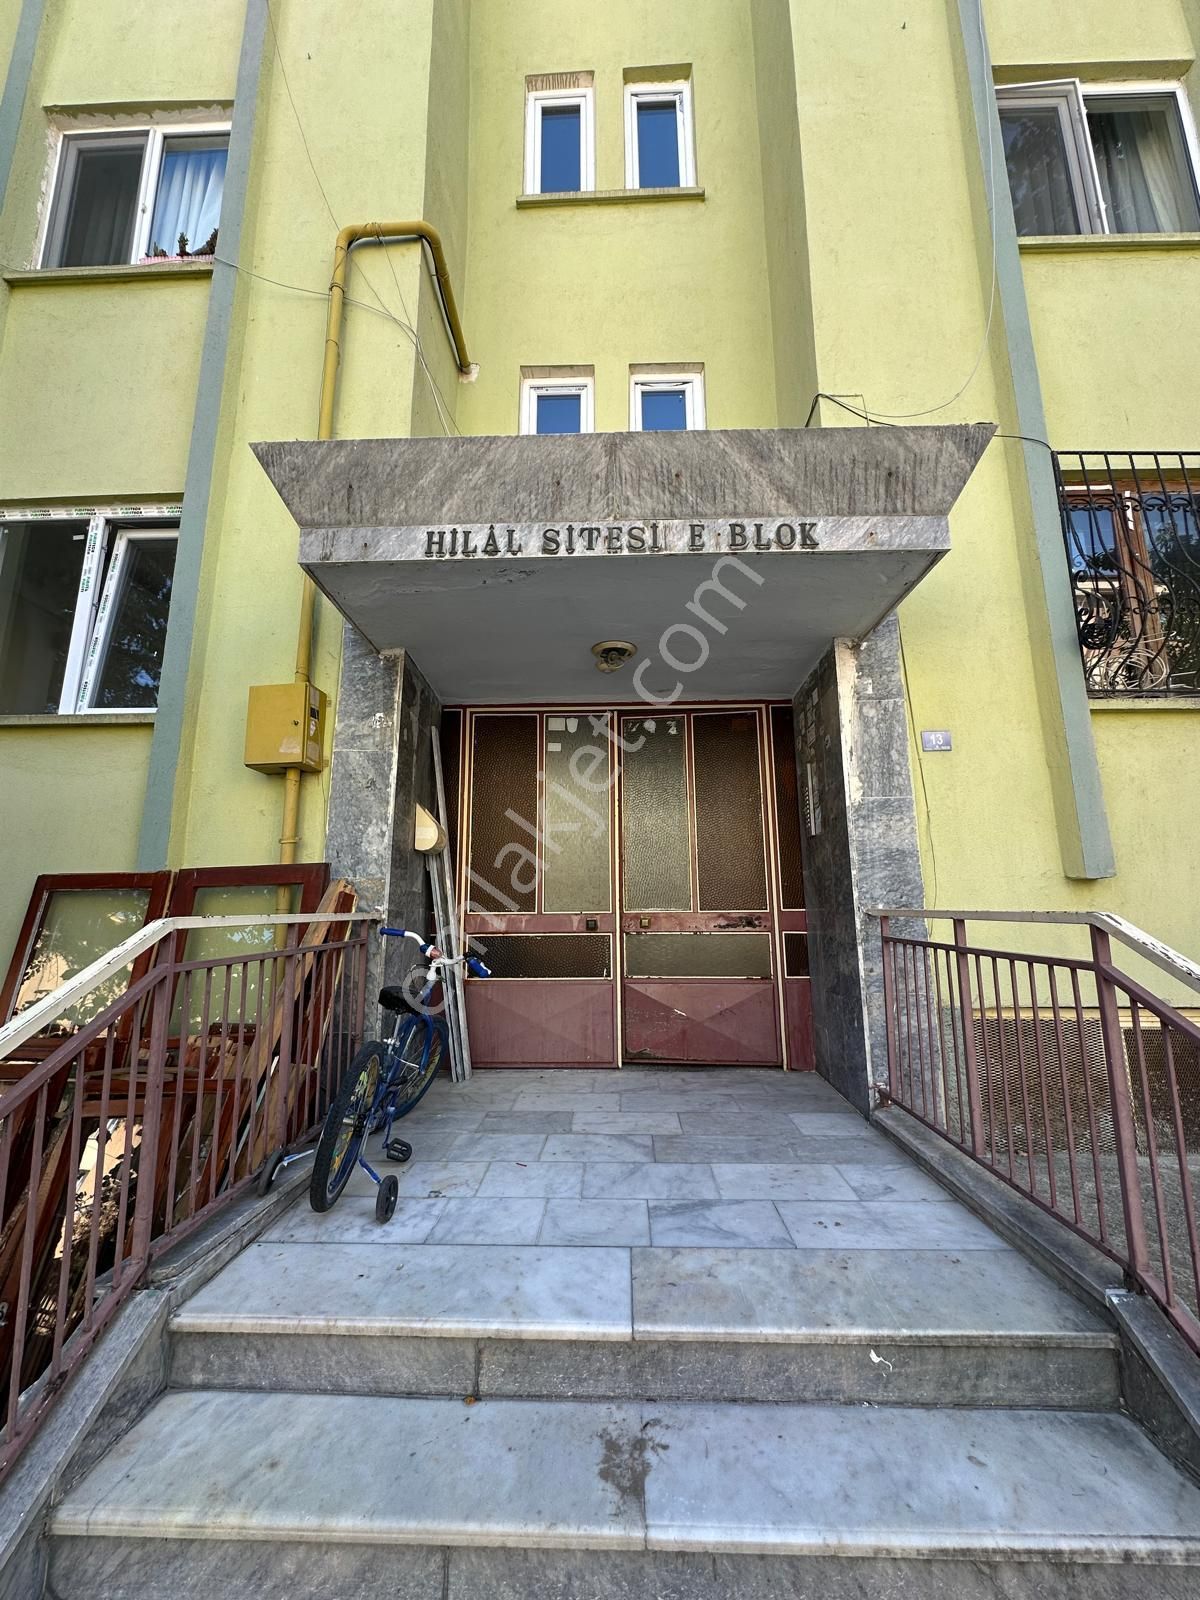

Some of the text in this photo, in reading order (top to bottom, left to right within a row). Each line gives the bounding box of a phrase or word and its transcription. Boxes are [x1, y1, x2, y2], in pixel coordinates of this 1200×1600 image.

[541, 522, 660, 554] SİTESİ
[688, 523, 705, 551] E
[728, 522, 820, 550] BLOK
[930, 733, 943, 745] 13
